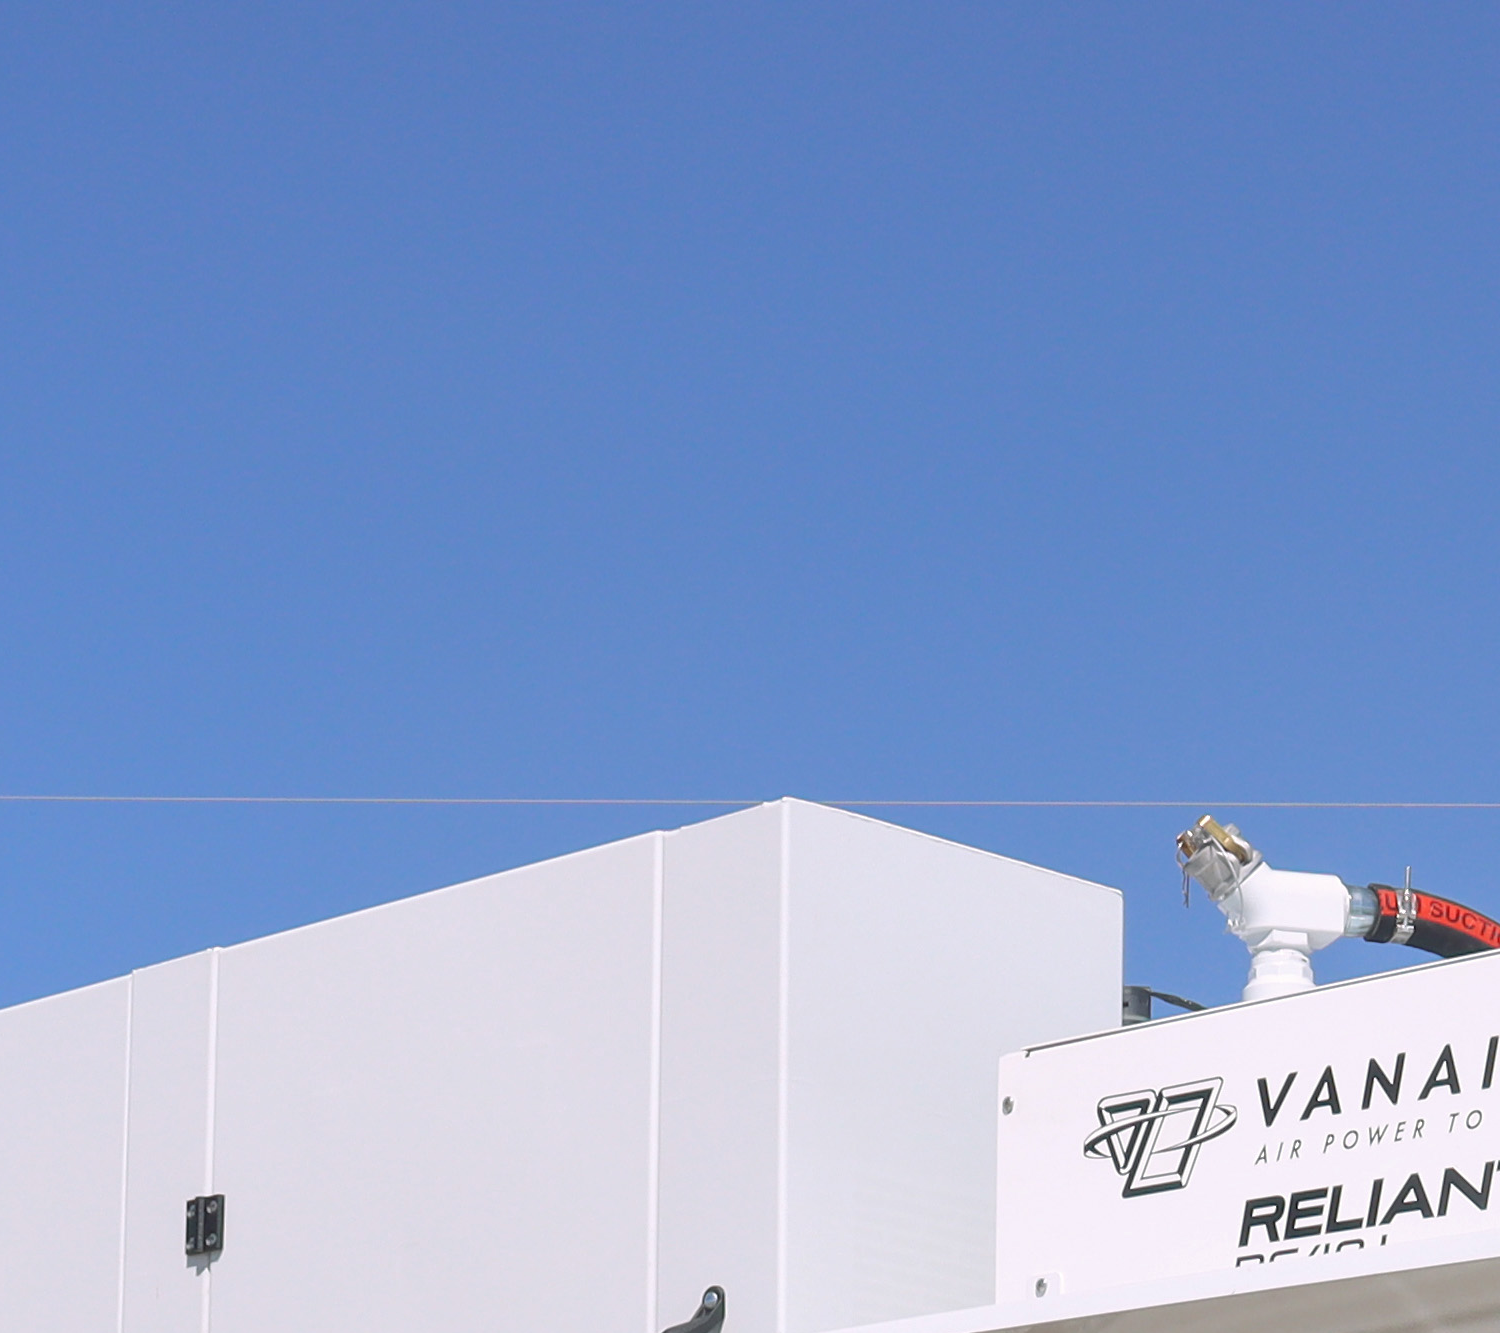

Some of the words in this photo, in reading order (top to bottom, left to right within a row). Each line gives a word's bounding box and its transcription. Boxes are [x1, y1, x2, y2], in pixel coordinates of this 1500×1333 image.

[1255, 1139, 1302, 1166] AIR
[1323, 1119, 1425, 1154] POWER
[1448, 1109, 1483, 1134] TO
